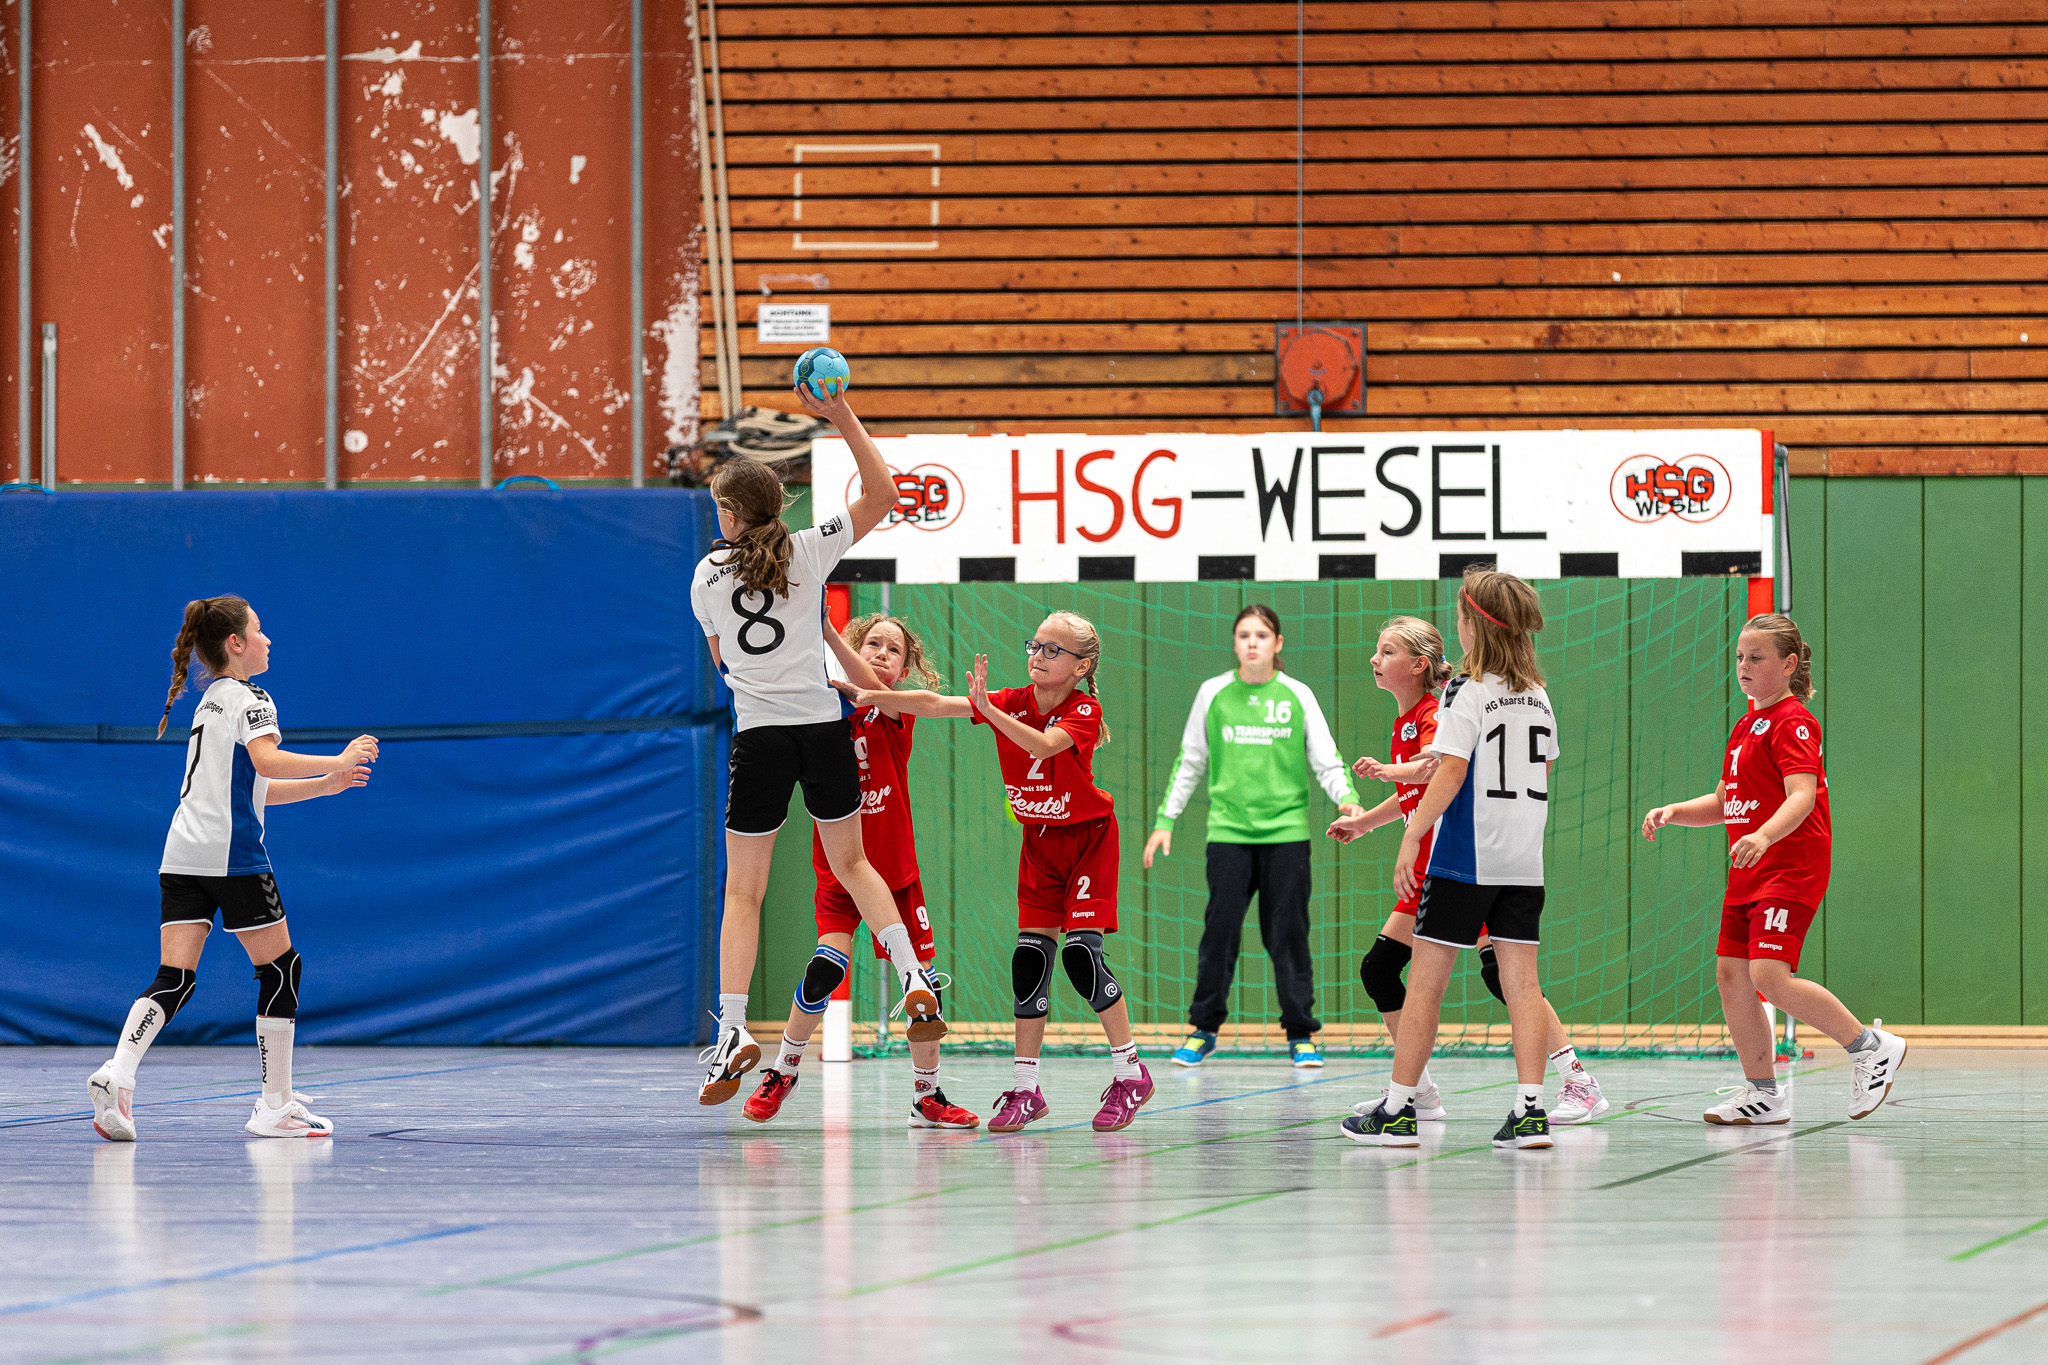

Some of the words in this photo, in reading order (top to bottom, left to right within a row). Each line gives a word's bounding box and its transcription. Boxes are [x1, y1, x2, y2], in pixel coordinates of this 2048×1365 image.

[889, 474, 949, 512] SG
[1625, 465, 1714, 503] HSG
[889, 507, 947, 523] ESEL
[1635, 498, 1710, 516] WESEL
[706, 573, 719, 587] HG
[731, 584, 785, 655] 8
[1264, 699, 1292, 724] 16
[1485, 700, 1498, 714] HG
[1498, 696, 1525, 707] Kaarst
[1234, 725, 1293, 739] TEAMSPORT
[180, 723, 204, 798] 7
[1027, 753, 1044, 780] 2
[1486, 723, 1551, 801] 15
[1076, 875, 1091, 900] 2
[916, 905, 930, 931] 9
[1072, 911, 1095, 919] Kempa
[1764, 907, 1789, 933] 14
[1758, 942, 1783, 951] Kempa
[128, 1007, 158, 1045] Kempa
[258, 1035, 269, 1083] Kempa
